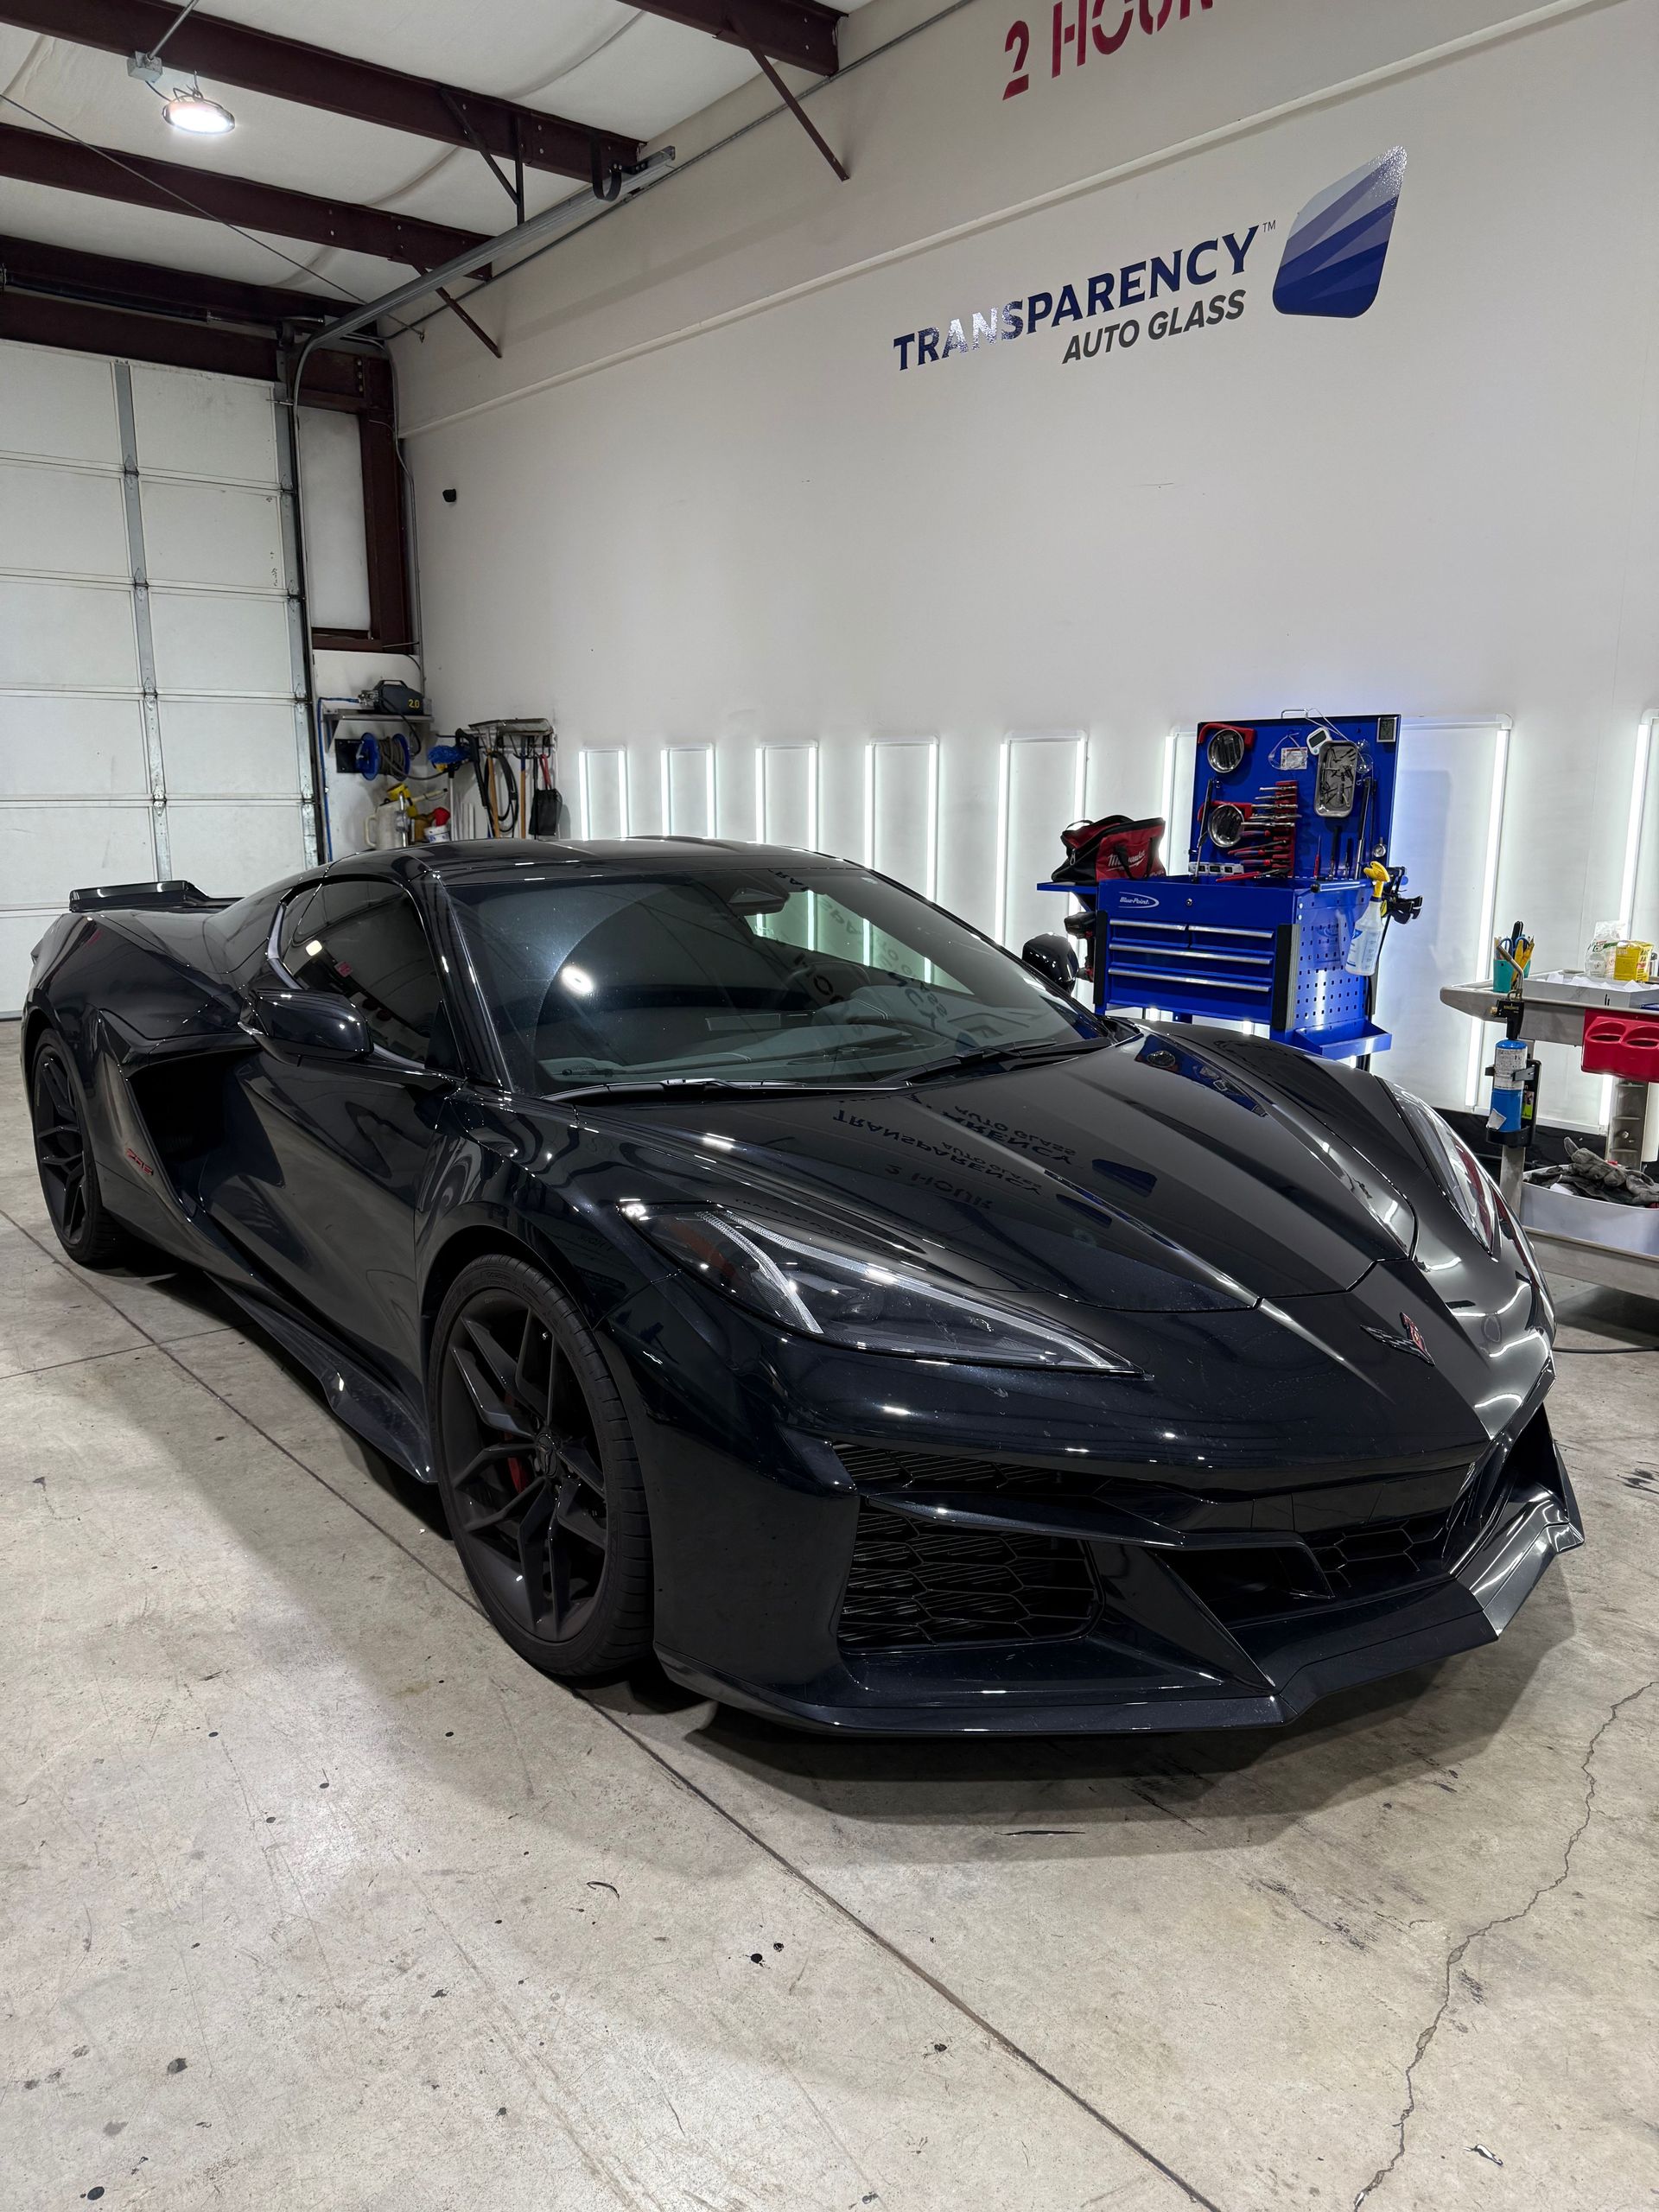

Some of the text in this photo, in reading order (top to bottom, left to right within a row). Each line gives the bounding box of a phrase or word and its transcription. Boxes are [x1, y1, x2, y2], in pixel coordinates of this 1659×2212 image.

[1002, 0, 1213, 100] 2 HOU
[893, 225, 1259, 371] TRANSPARENCY
[1062, 289, 1246, 364] AUTO GLASS
